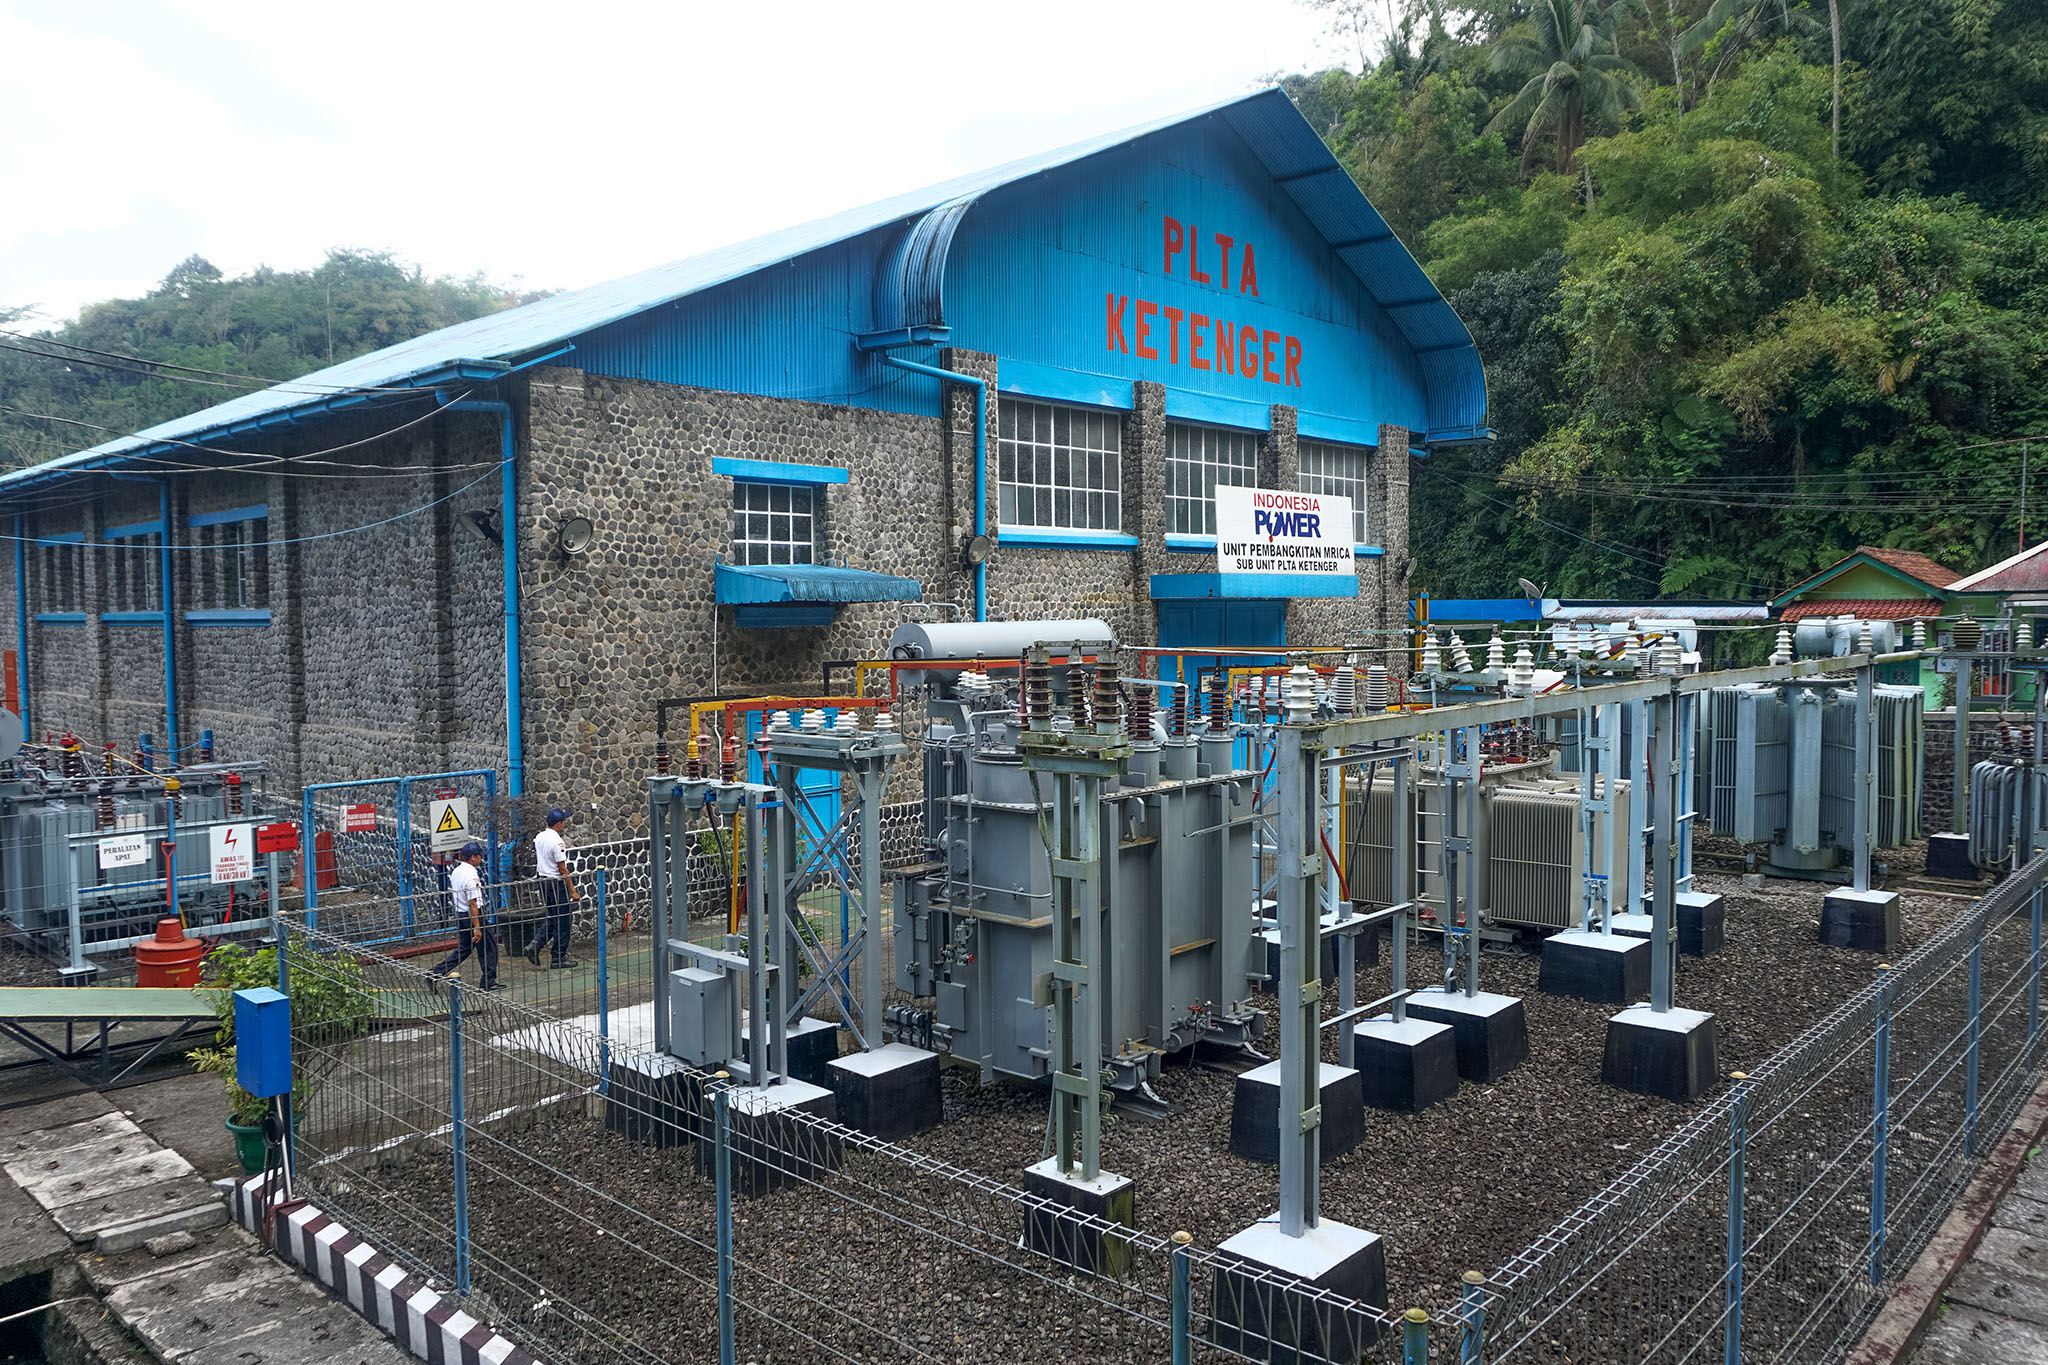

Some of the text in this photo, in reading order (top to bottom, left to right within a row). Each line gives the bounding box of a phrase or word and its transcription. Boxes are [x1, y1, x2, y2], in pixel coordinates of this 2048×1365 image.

[1163, 215, 1259, 298] PLTA
[1106, 292, 1302, 388] KETENGER
[1253, 493, 1320, 512] INDONESIA
[1254, 510, 1322, 539] POWER
[1223, 542, 1351, 560] UNIT PEMBANGKITAN MRICA
[1236, 558, 1338, 572] SUB UNIT PLTA KETENGER
[103, 844, 142, 855] PERALATAN
